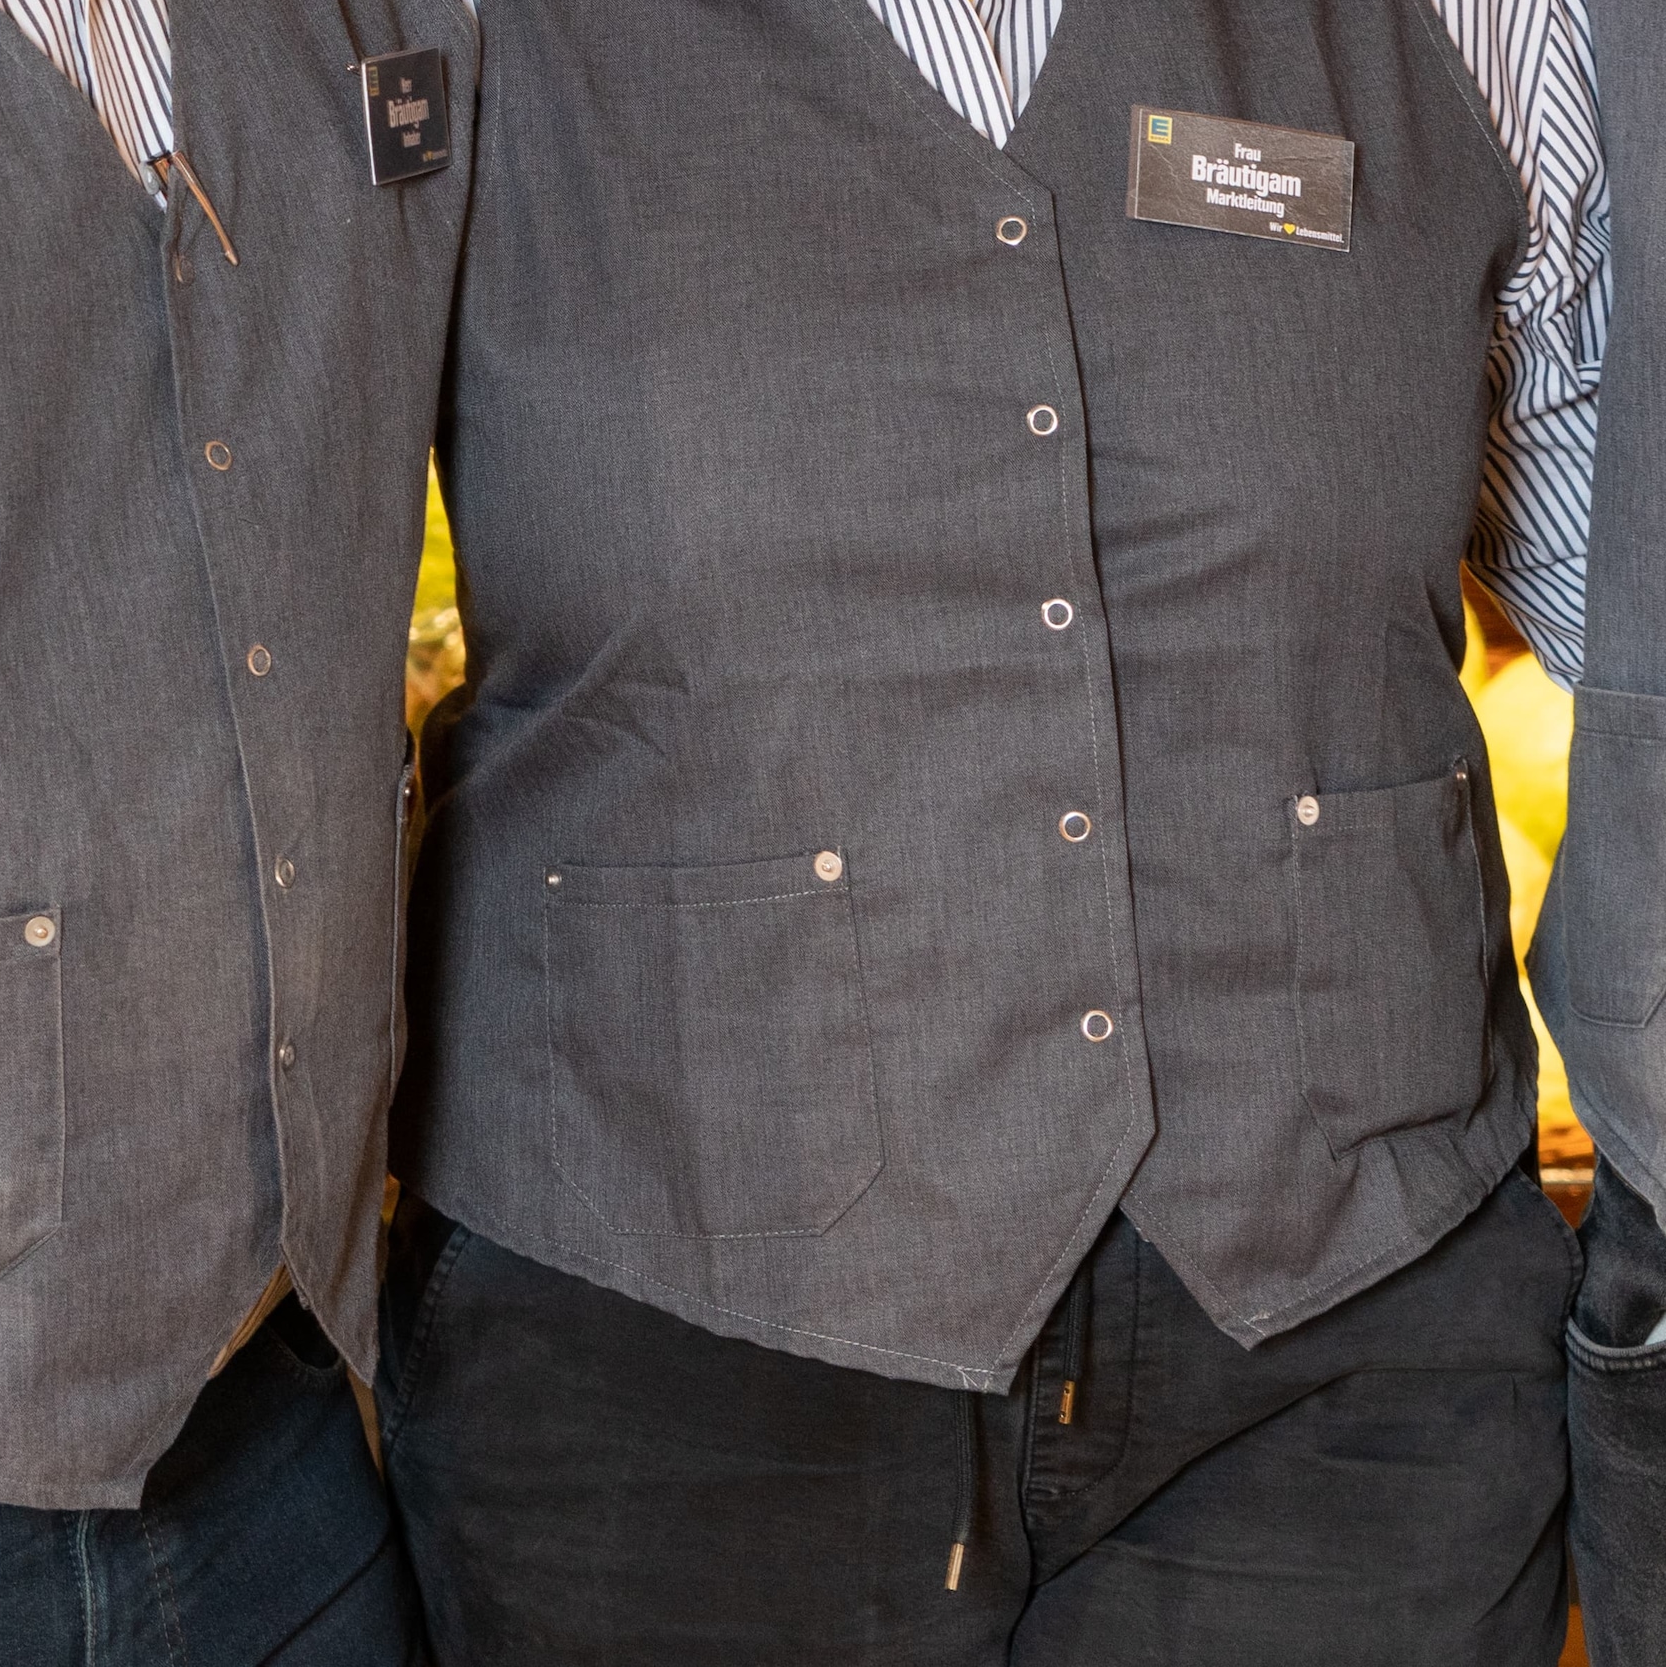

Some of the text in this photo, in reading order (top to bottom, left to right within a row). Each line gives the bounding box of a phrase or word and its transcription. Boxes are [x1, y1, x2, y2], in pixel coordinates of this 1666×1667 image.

[386, 95, 430, 130] Bräutigam
[1234, 143, 1262, 162] Frau
[1191, 154, 1302, 198] Bräutigam
[1206, 188, 1285, 218] Marktleitung
[1269, 221, 1345, 244] Wir Lebensmittel.
